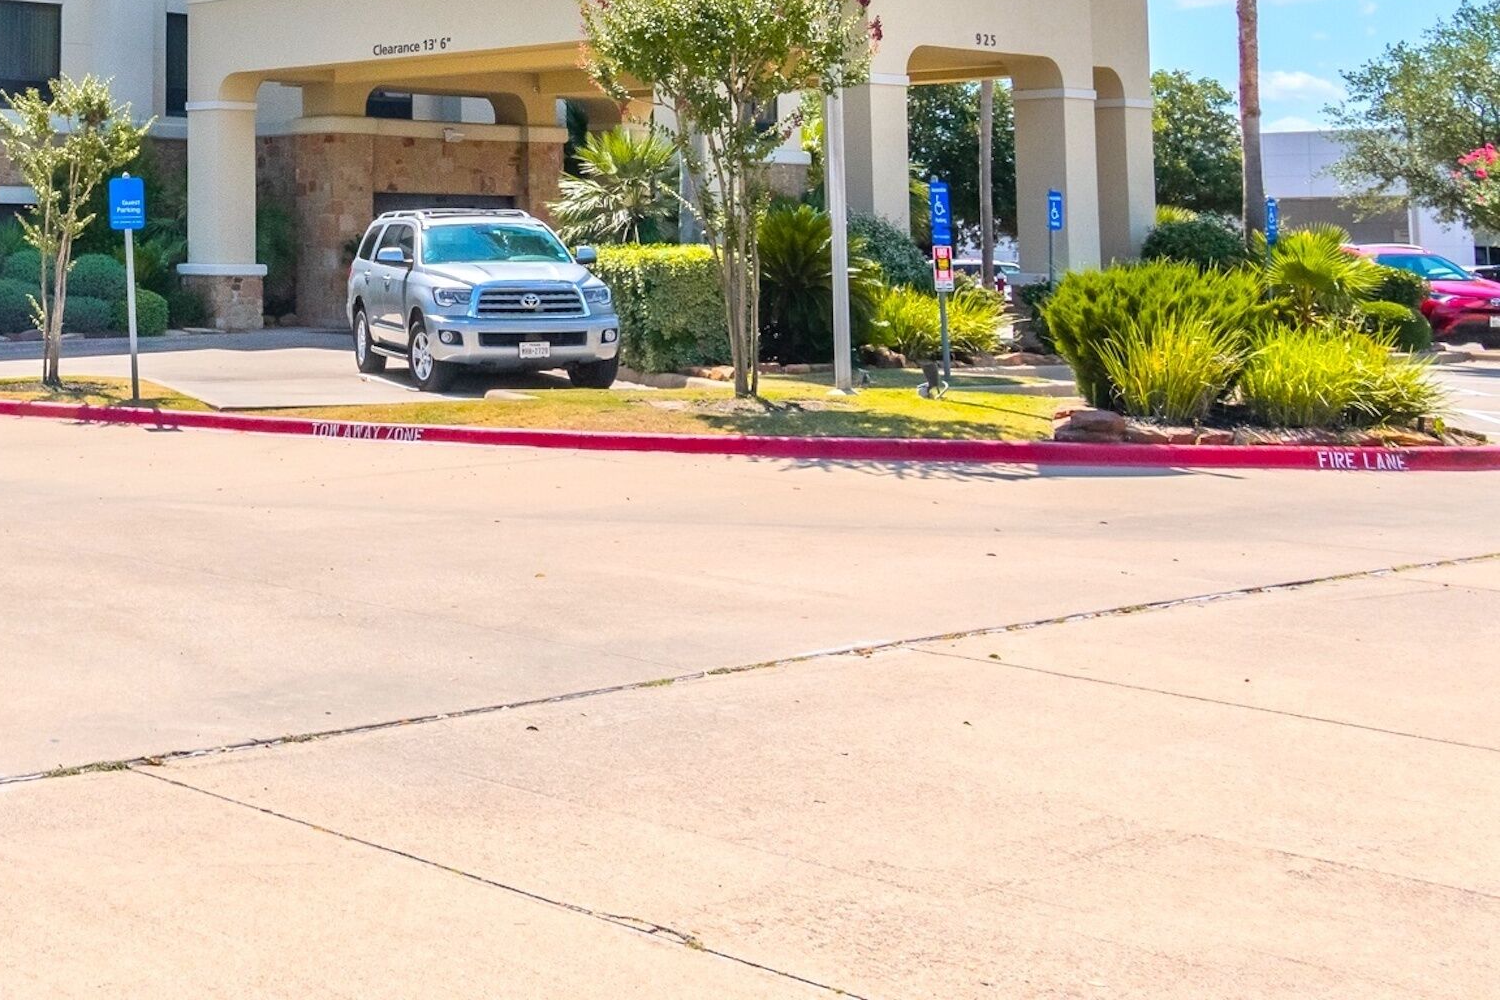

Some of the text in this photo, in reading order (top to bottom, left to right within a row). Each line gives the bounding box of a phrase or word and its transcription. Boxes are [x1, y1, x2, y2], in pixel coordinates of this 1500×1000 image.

[373, 43, 420, 56] Clearance
[423, 39, 437, 50] 13'
[975, 33, 997, 47] 925
[116, 206, 141, 214] Parking
[312, 422, 424, 441] TOW AWAY ZONE
[1317, 451, 1409, 470] FIRE LANE
